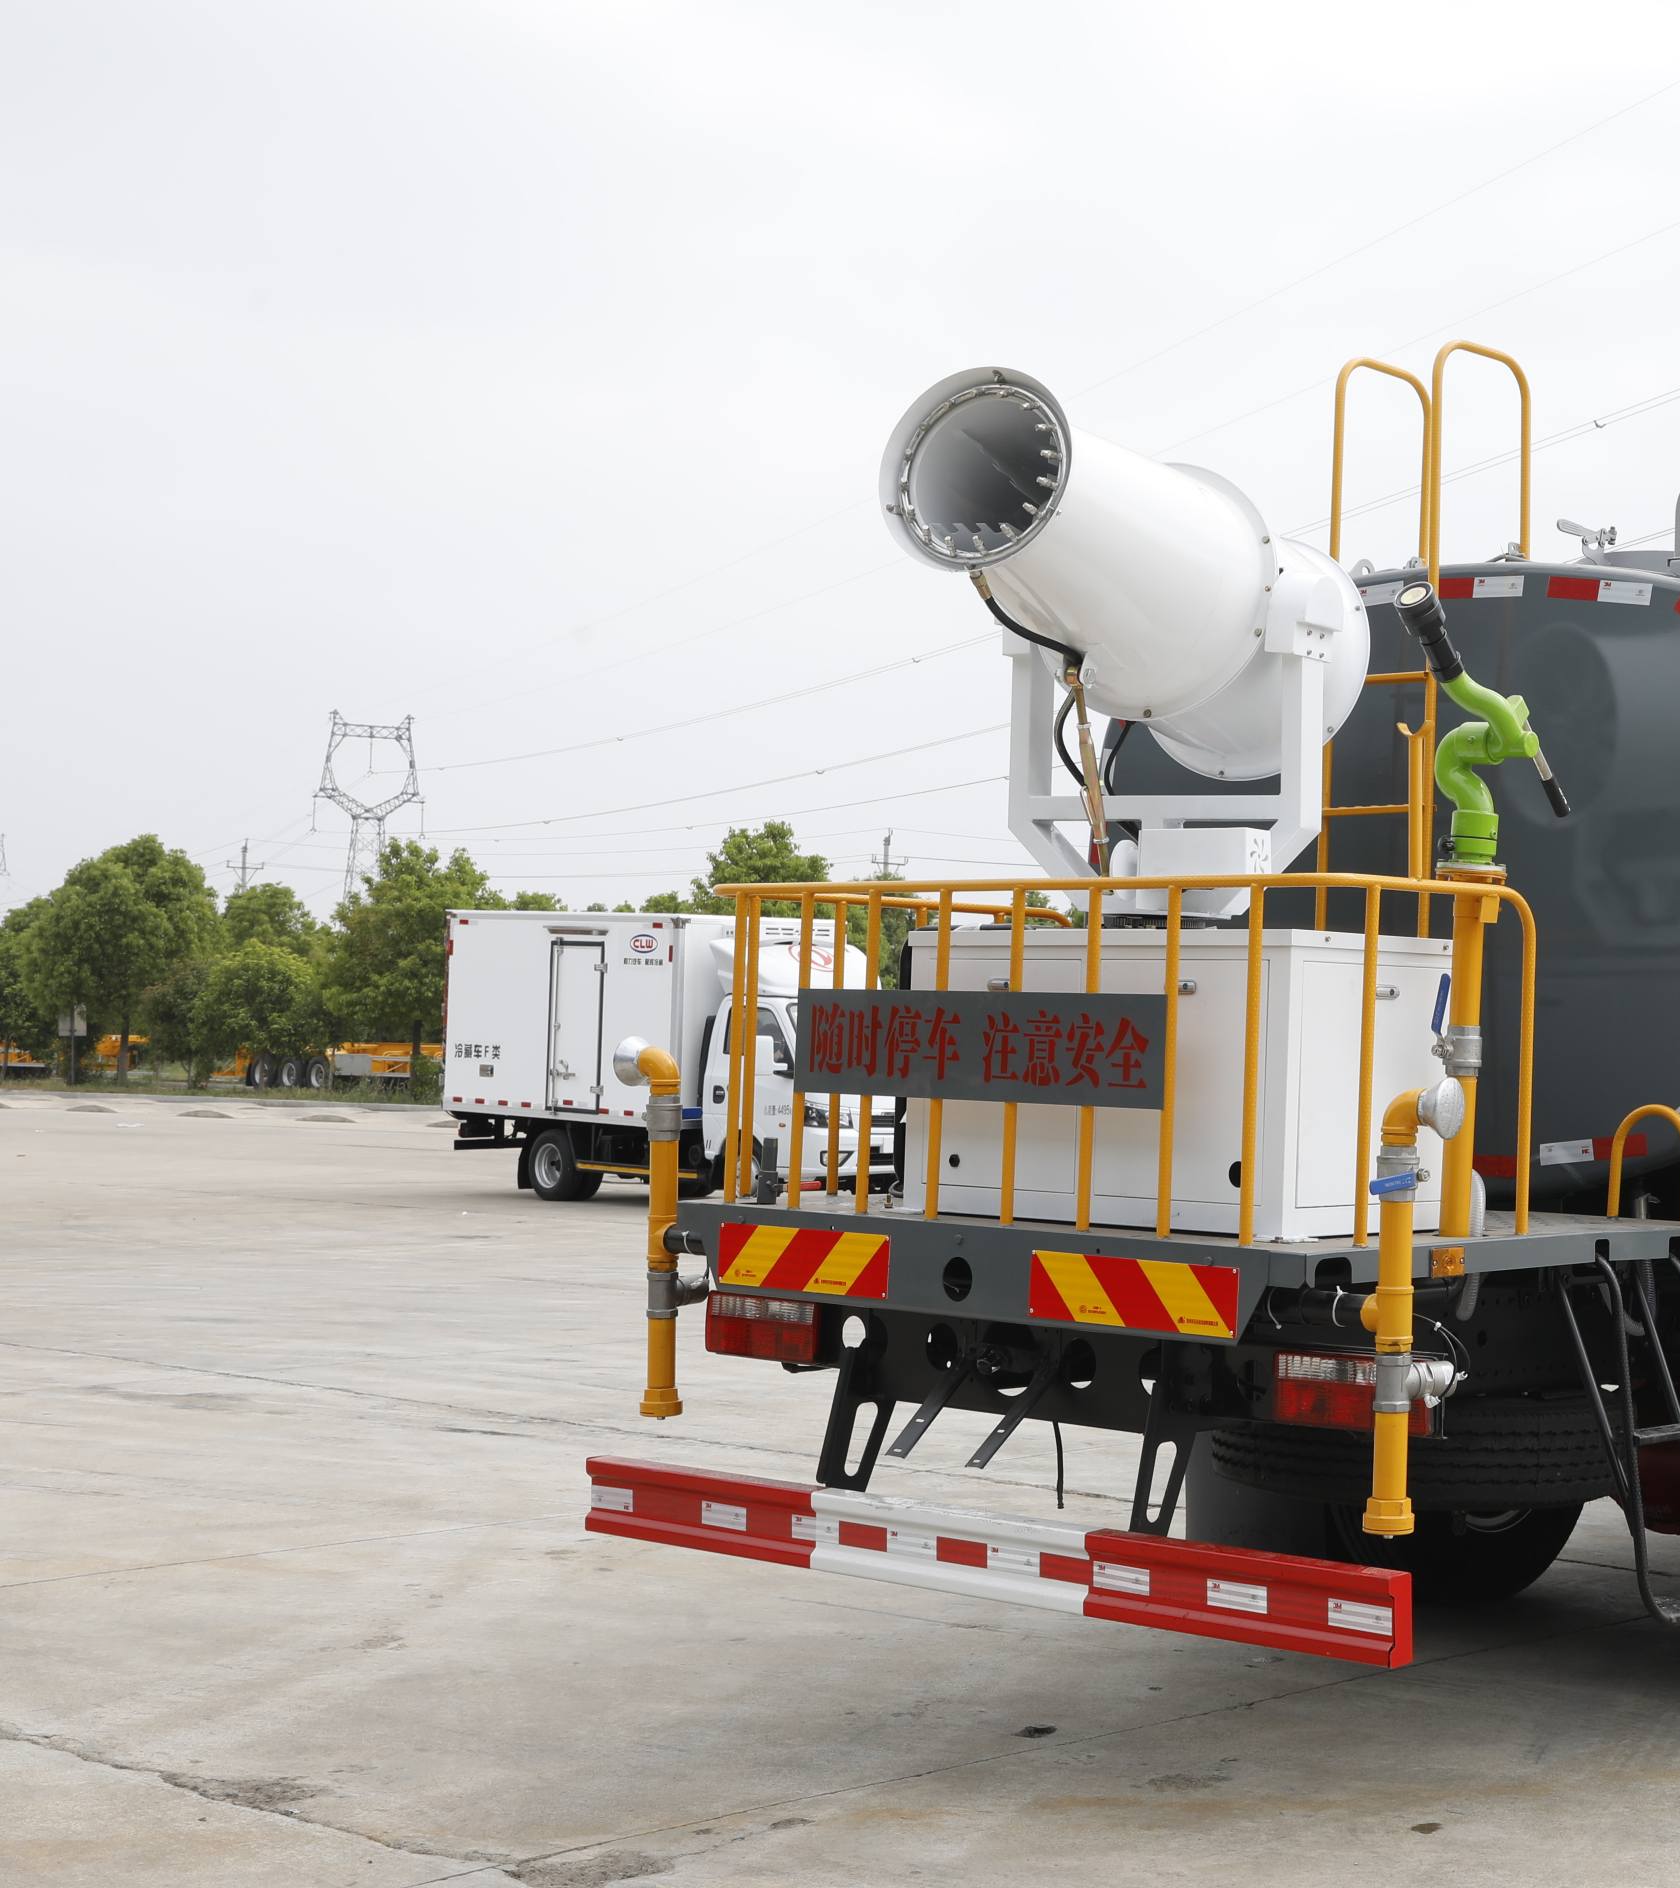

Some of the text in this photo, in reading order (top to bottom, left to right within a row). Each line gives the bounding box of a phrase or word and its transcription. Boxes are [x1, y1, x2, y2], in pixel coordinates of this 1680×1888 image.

[633, 939, 654, 949] CLW
[809, 1002, 1150, 1089] 随时停车 注意安全
